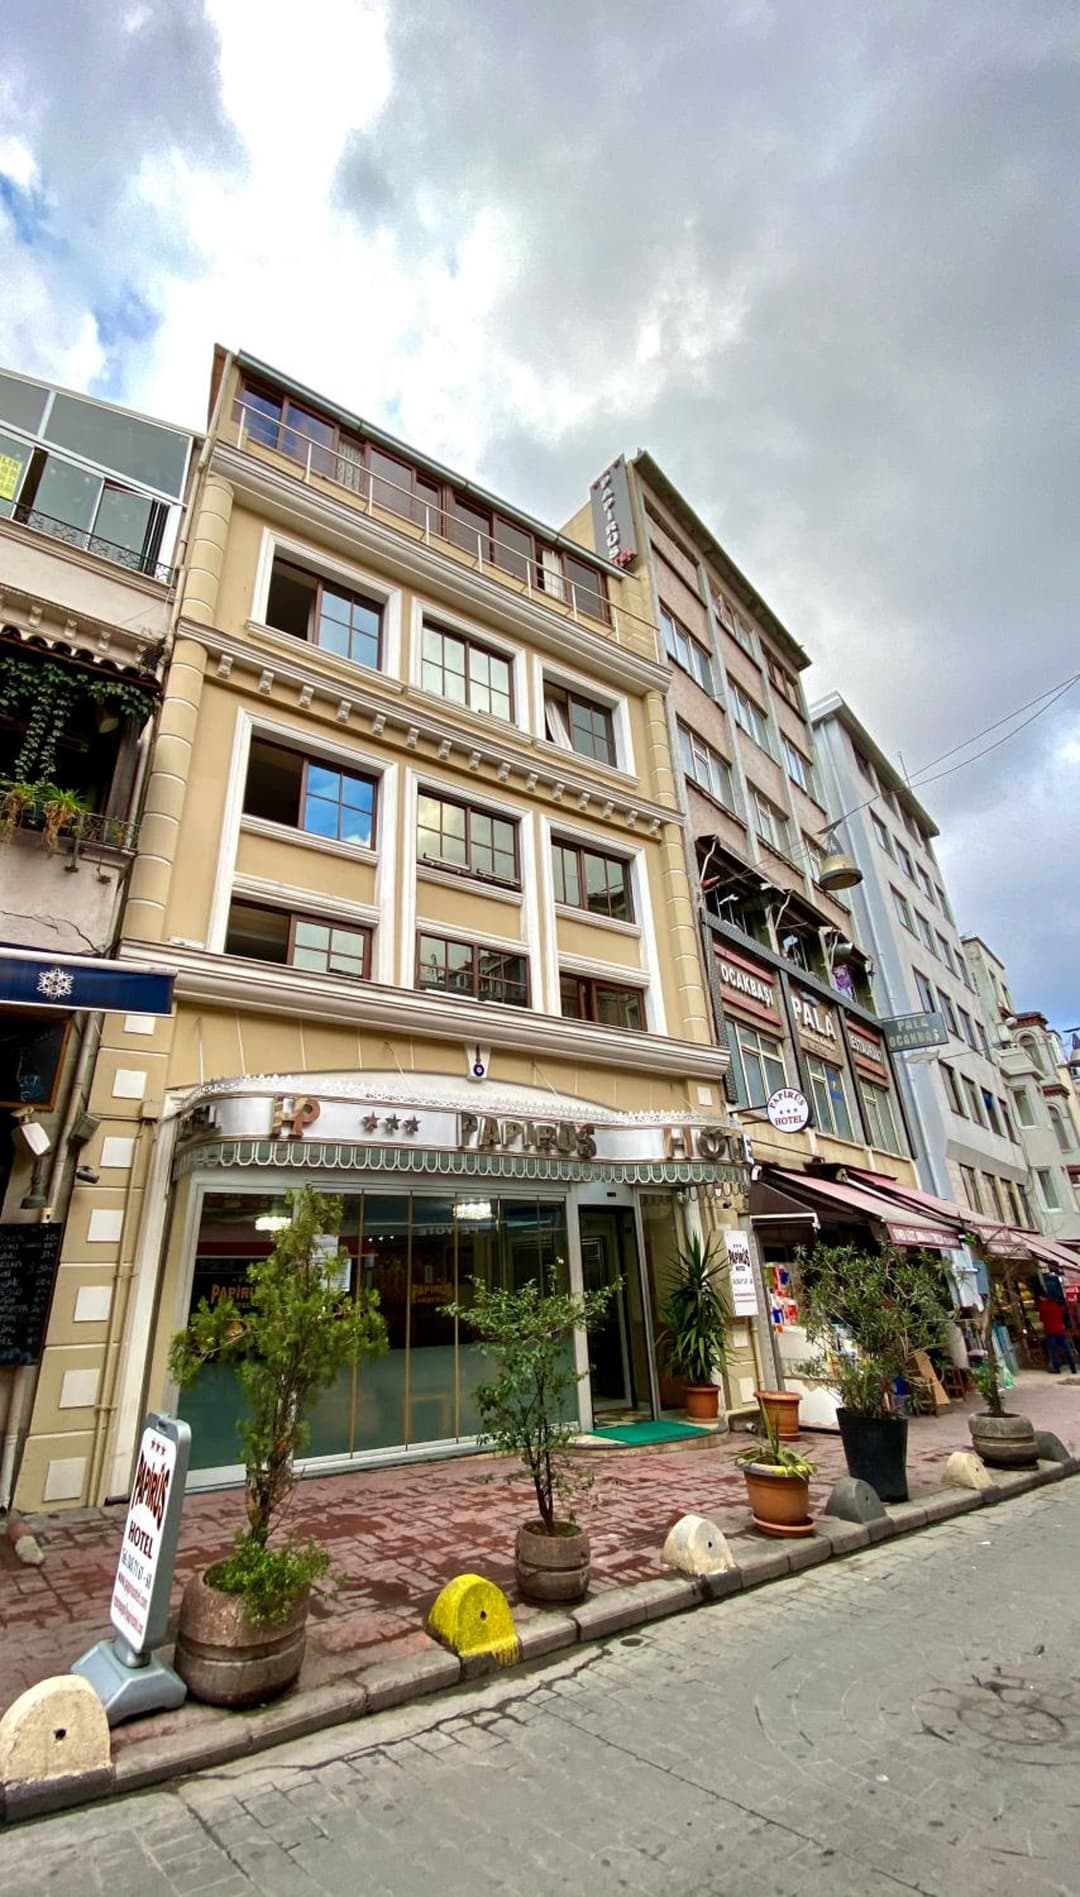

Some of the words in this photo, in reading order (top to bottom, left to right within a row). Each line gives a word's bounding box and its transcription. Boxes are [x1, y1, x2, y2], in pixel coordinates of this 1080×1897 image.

[721, 963, 774, 1008] OCAKBAŞI
[775, 1115, 804, 1126] HOTEL
[128, 1520, 153, 1559] HOTEL
